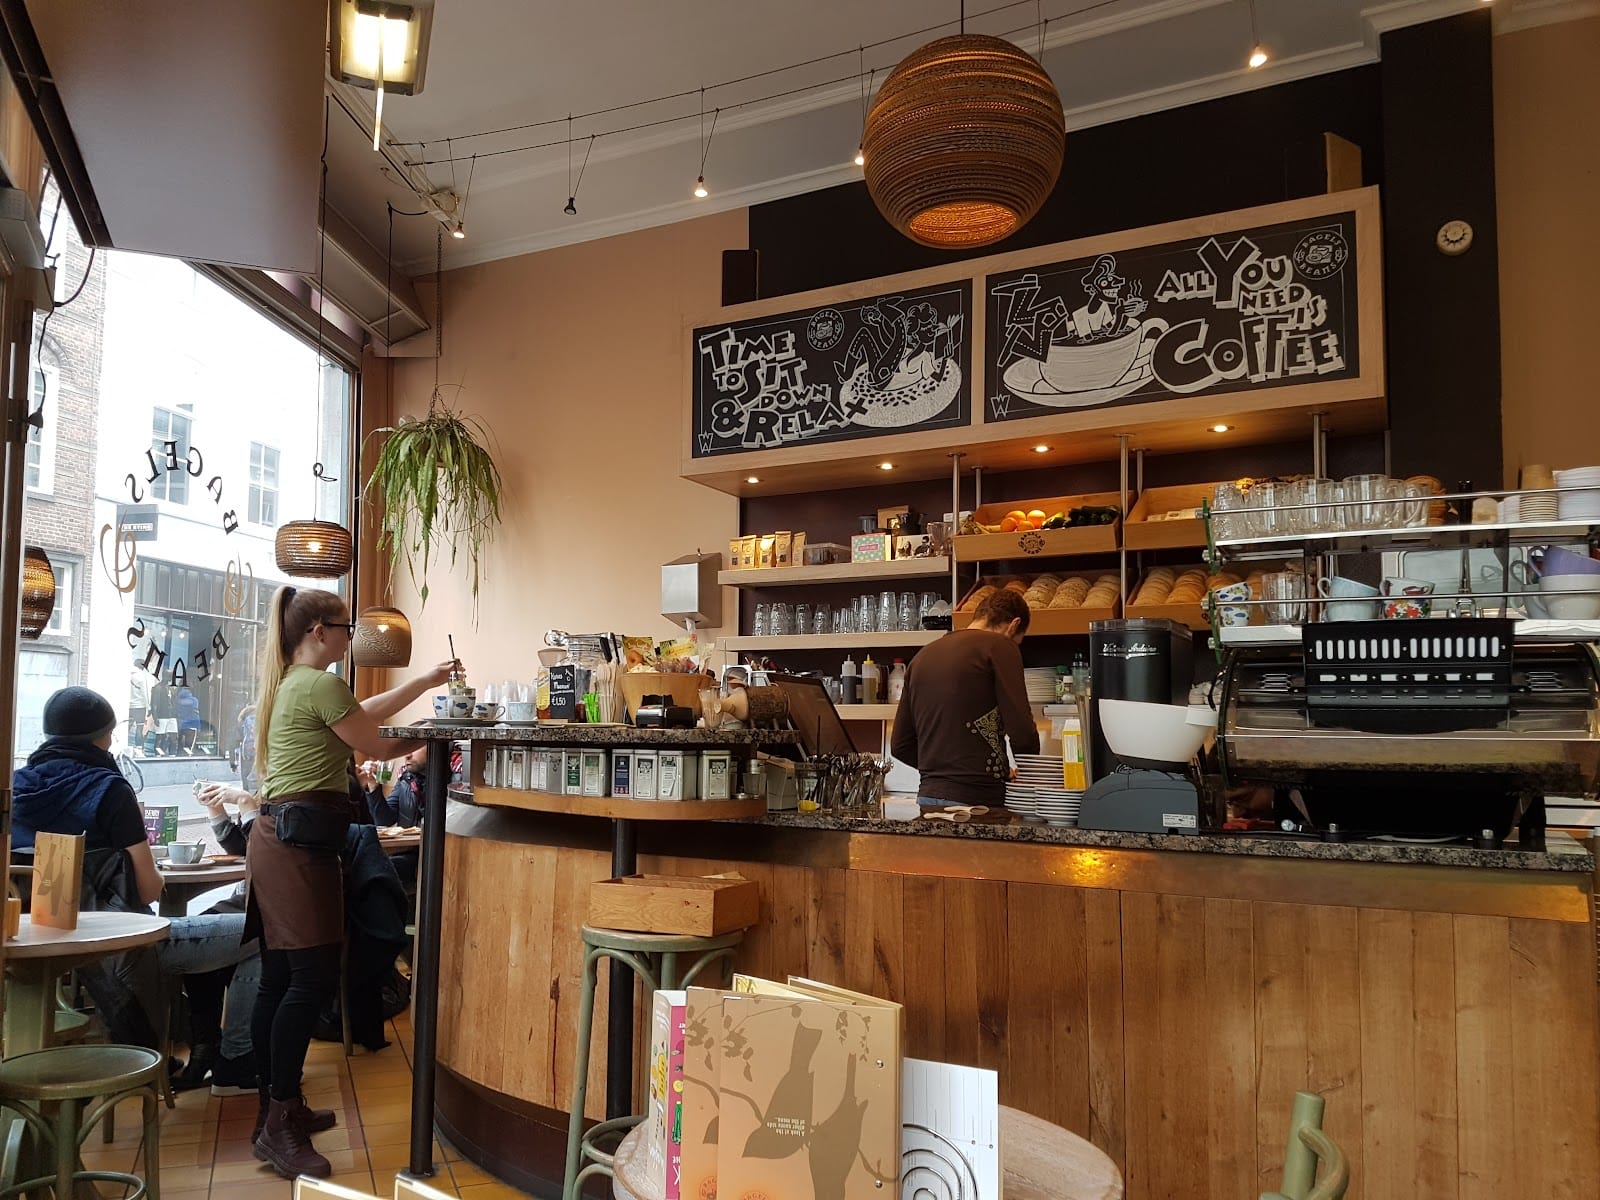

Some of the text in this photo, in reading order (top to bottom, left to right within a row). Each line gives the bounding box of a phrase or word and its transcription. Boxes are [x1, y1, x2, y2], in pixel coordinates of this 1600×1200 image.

[1302, 233, 1342, 248] BAGELS
[1154, 236, 1293, 309] ALL YOU
[1300, 262, 1337, 276] BEANS
[811, 311, 839, 327] BAGELS
[1239, 283, 1328, 330] NEED IS
[699, 328, 796, 371] TIME
[812, 334, 839, 348] BEANS
[1151, 315, 1346, 394] COFFEE
[712, 357, 808, 406] TO SIT
[758, 384, 832, 410] DOWN
[711, 397, 869, 448] & RELAX
